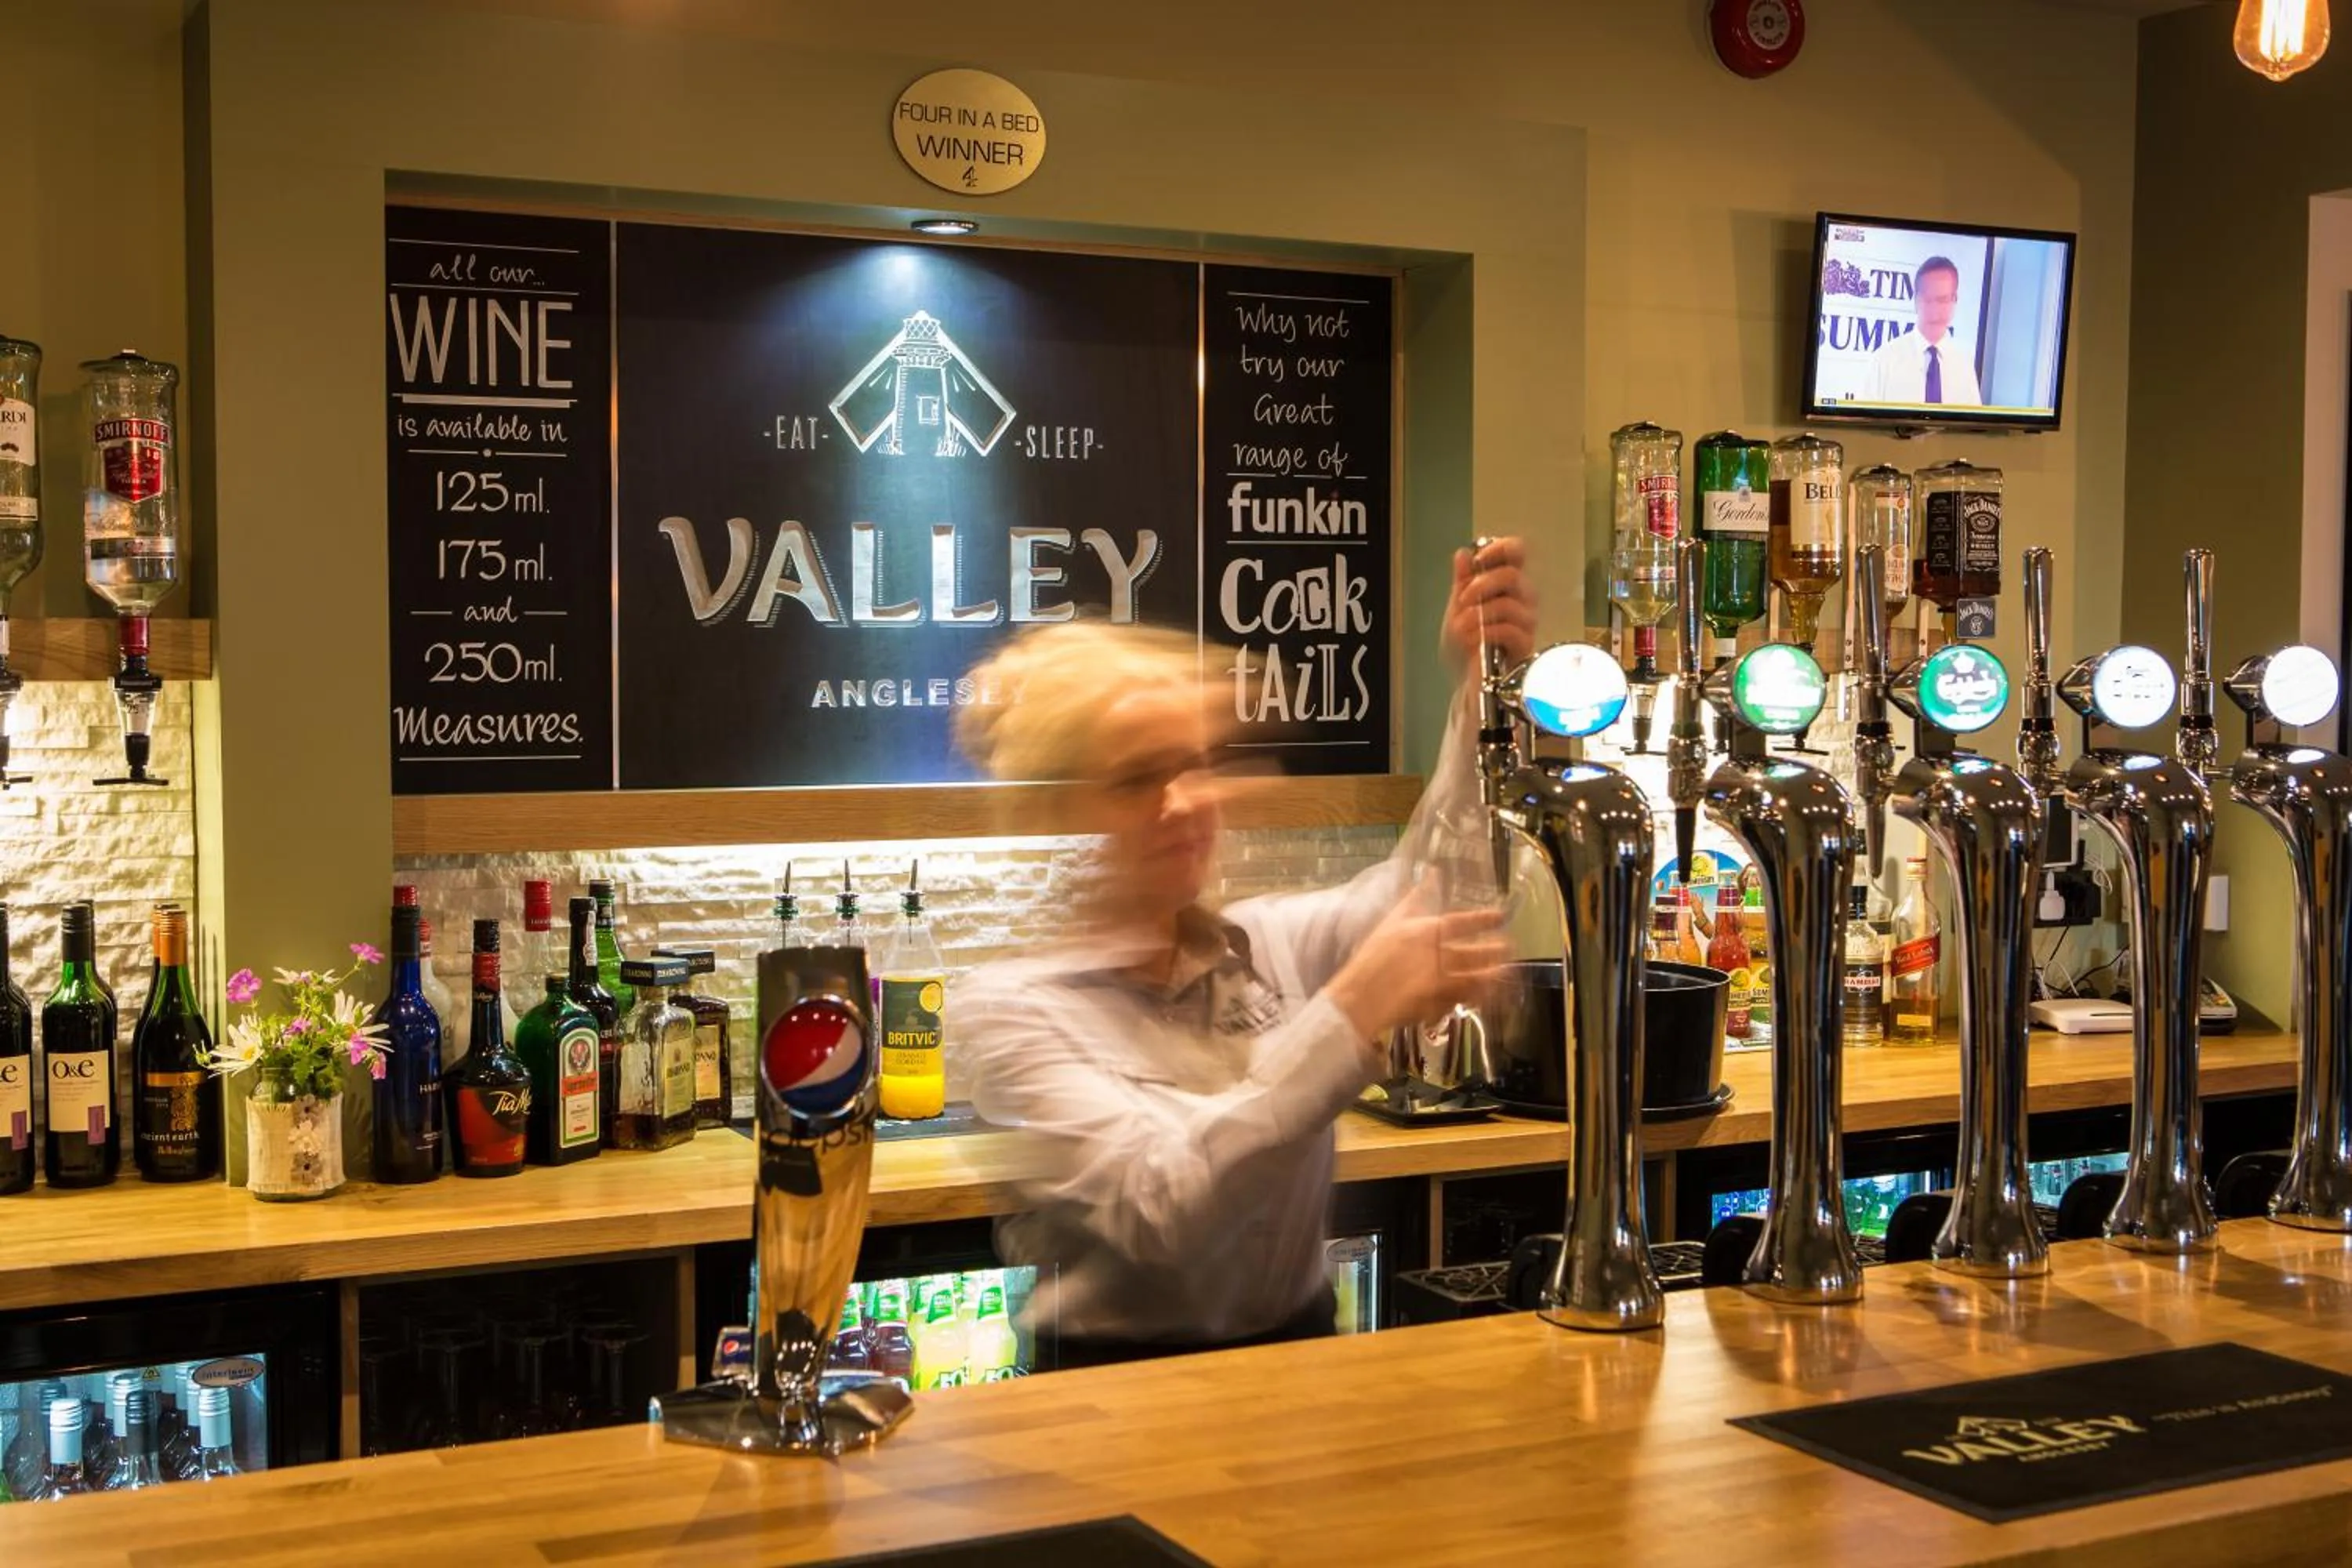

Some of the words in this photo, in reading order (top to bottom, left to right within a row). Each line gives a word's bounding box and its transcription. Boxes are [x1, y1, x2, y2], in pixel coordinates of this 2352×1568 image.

[899, 102, 951, 124] FOUR
[957, 108, 976, 126] IN
[982, 111, 996, 129] A
[1001, 112, 1039, 132] BED
[916, 134, 1023, 165] WINNER
[430, 253, 476, 281] all
[390, 292, 573, 389] WINE
[1235, 303, 1297, 343] Why
[1305, 309, 1349, 338] not
[1240, 344, 1284, 383] try
[1298, 356, 1345, 377] our
[1254, 393, 1334, 425] Great
[397, 414, 418, 437] is
[426, 413, 532, 441] available
[541, 419, 568, 442] in
[1232, 443, 1308, 476] range
[1318, 441, 1348, 477] of
[1227, 481, 1367, 535] funkin
[658, 516, 1163, 627] VALLEY
[463, 596, 518, 623] and
[393, 706, 584, 746] Measures.
[887, 1030, 936, 1046] BRITVIC
[1902, 1414, 2147, 1466] VALLEY
